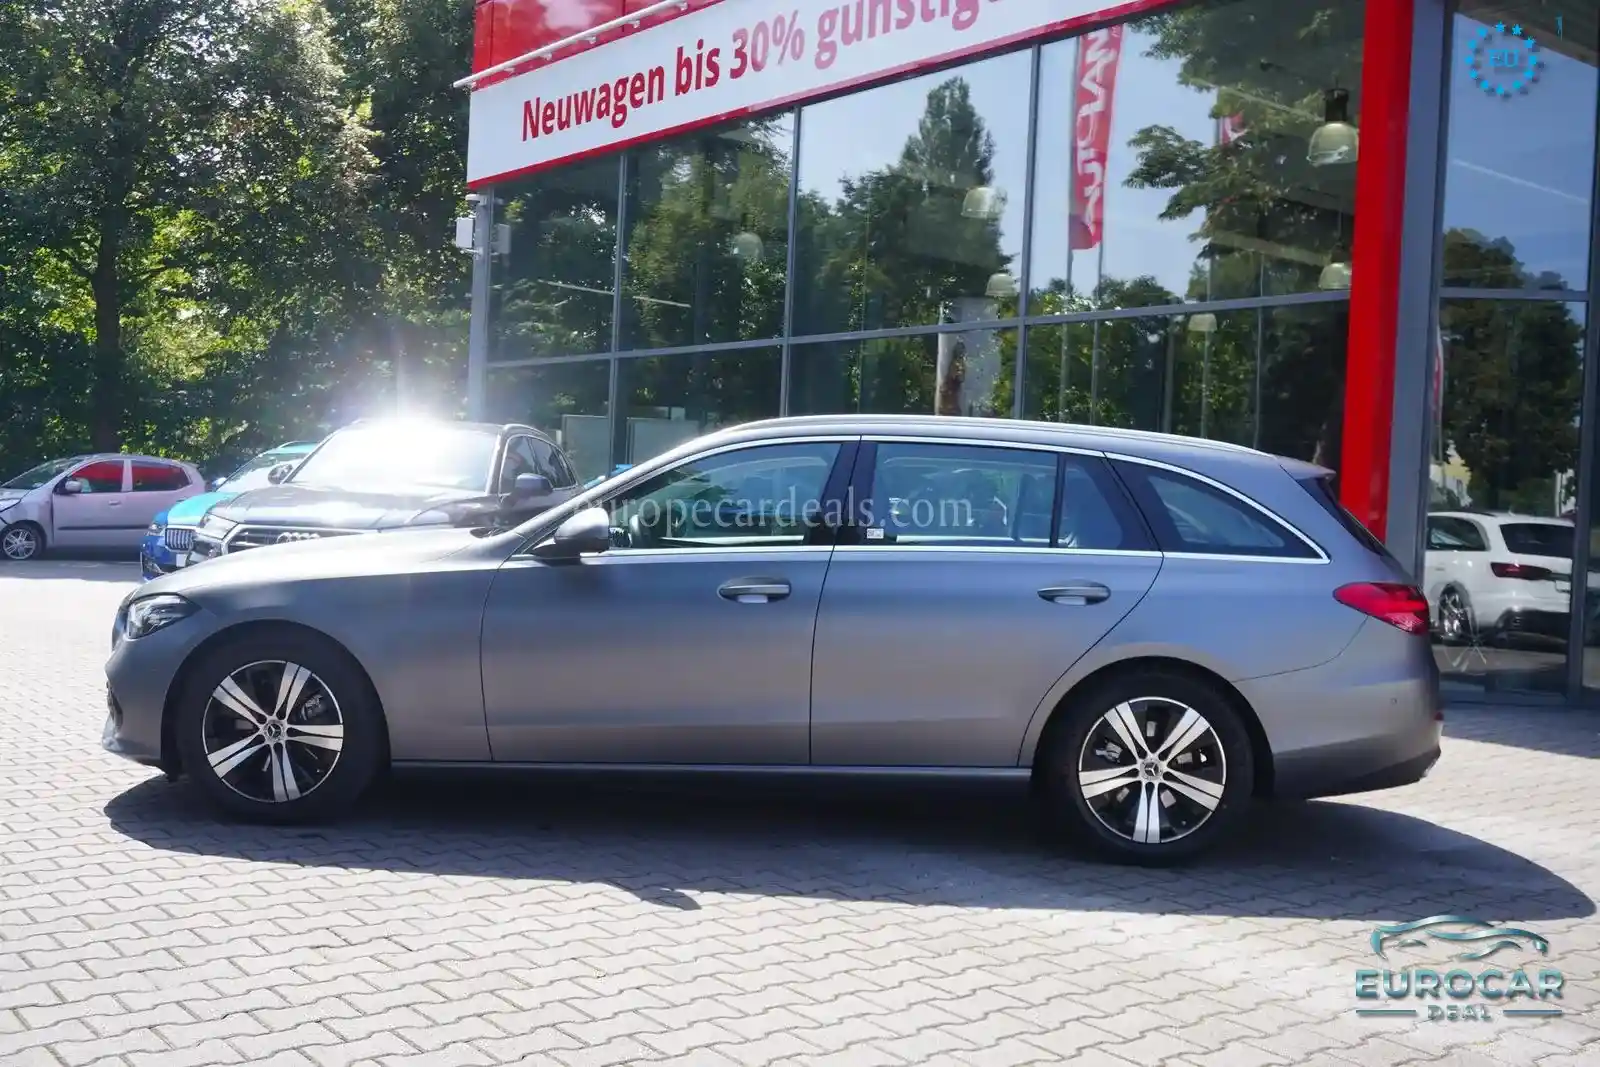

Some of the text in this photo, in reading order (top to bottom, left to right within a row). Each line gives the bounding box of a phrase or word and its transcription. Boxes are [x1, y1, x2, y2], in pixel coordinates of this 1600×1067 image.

[522, 66, 665, 141] Neuwagen
[675, 39, 721, 96] bis
[730, 11, 805, 80] 30%
